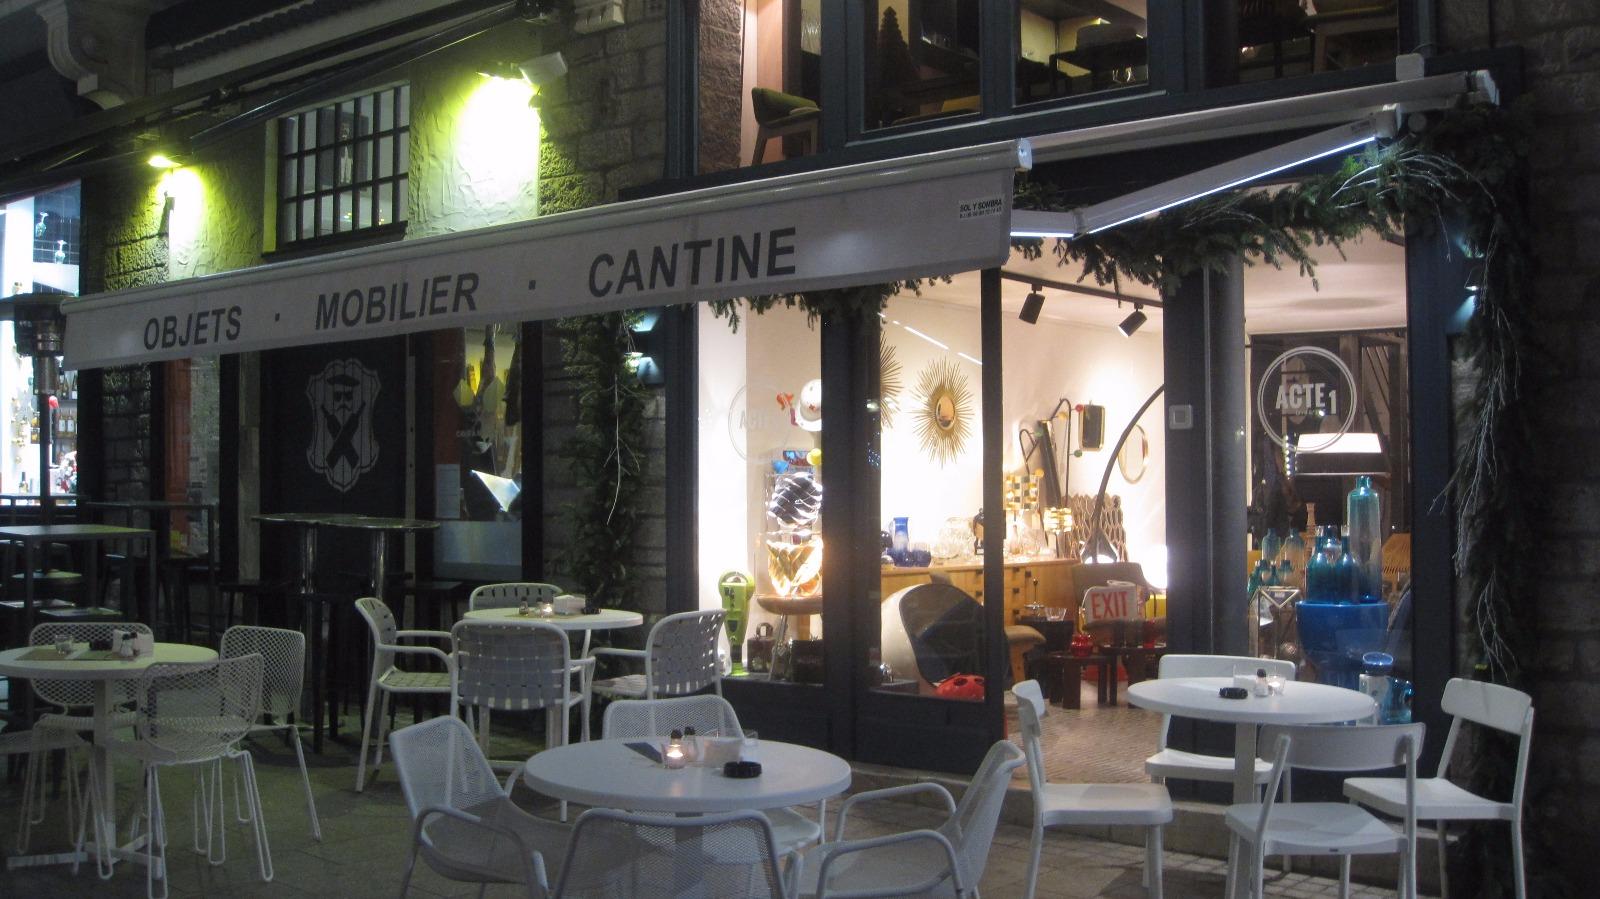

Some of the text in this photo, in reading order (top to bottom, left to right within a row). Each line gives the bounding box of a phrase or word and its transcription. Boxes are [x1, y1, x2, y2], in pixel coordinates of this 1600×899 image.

[960, 204, 971, 213] SOL
[978, 200, 1002, 210] SOMBRA
[143, 227, 796, 350] OBJETS MOBILIER CANTINE
[1275, 382, 1338, 415] ACTE 1
[1091, 591, 1128, 619] EXIT
